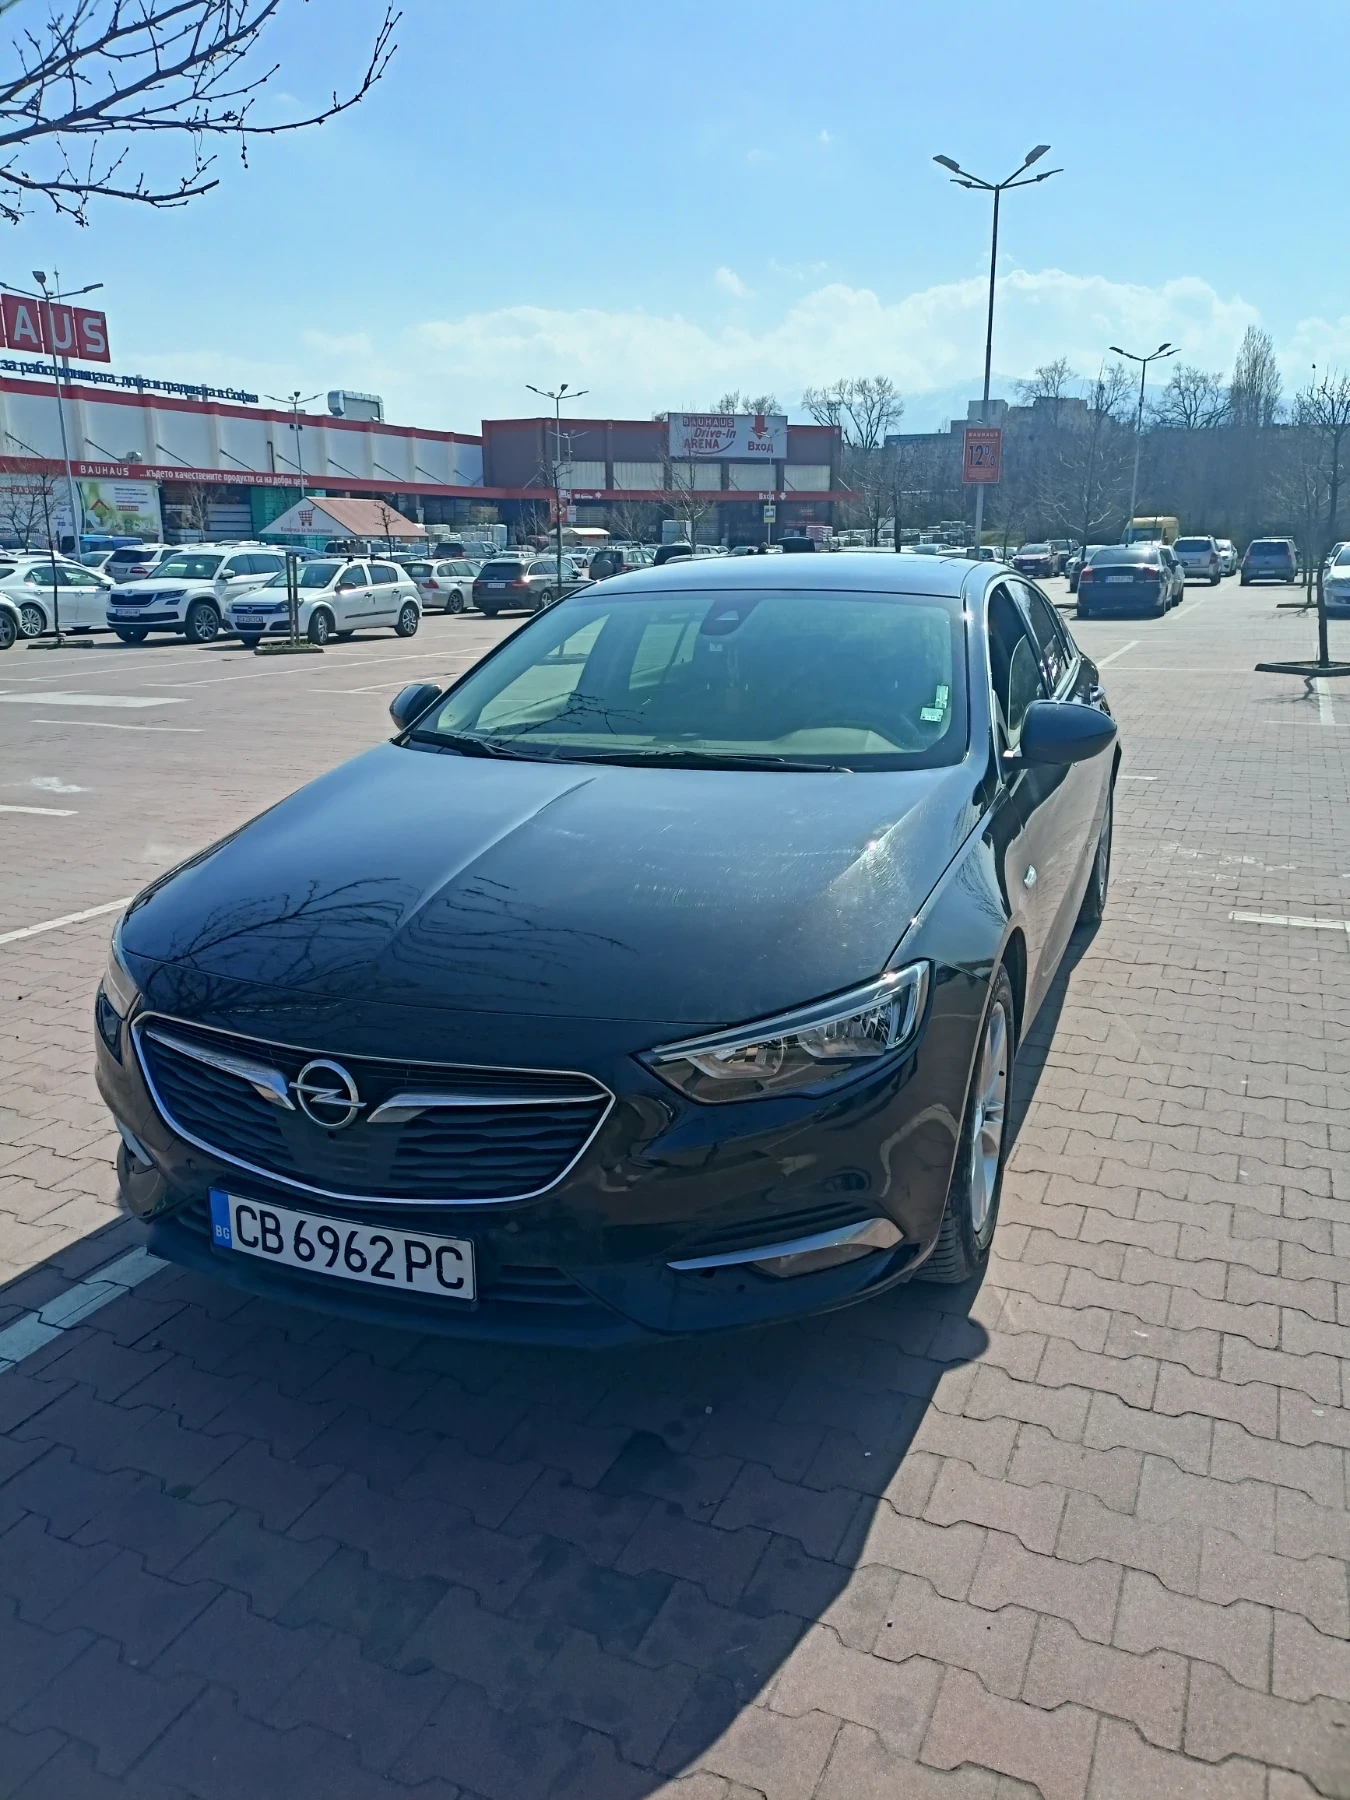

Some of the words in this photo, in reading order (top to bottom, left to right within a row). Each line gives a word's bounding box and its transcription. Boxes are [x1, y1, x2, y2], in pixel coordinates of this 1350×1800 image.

[683, 416, 734, 428] BAUHAUS
[694, 427, 737, 439] Drive-In
[683, 437, 720, 449] ARENA
[747, 441, 774, 453] Вход
[969, 444, 996, 467] 12%
[80, 464, 129, 475] BAUHAUS
[174, 471, 223, 482] качествените
[223, 474, 255, 485] продукти
[255, 476, 264, 484] са
[264, 476, 273, 484] на
[273, 475, 292, 487] добра
[758, 493, 775, 501] Вход
[215, 1224, 231, 1240] BG
[293, 1219, 396, 1280] 6962
